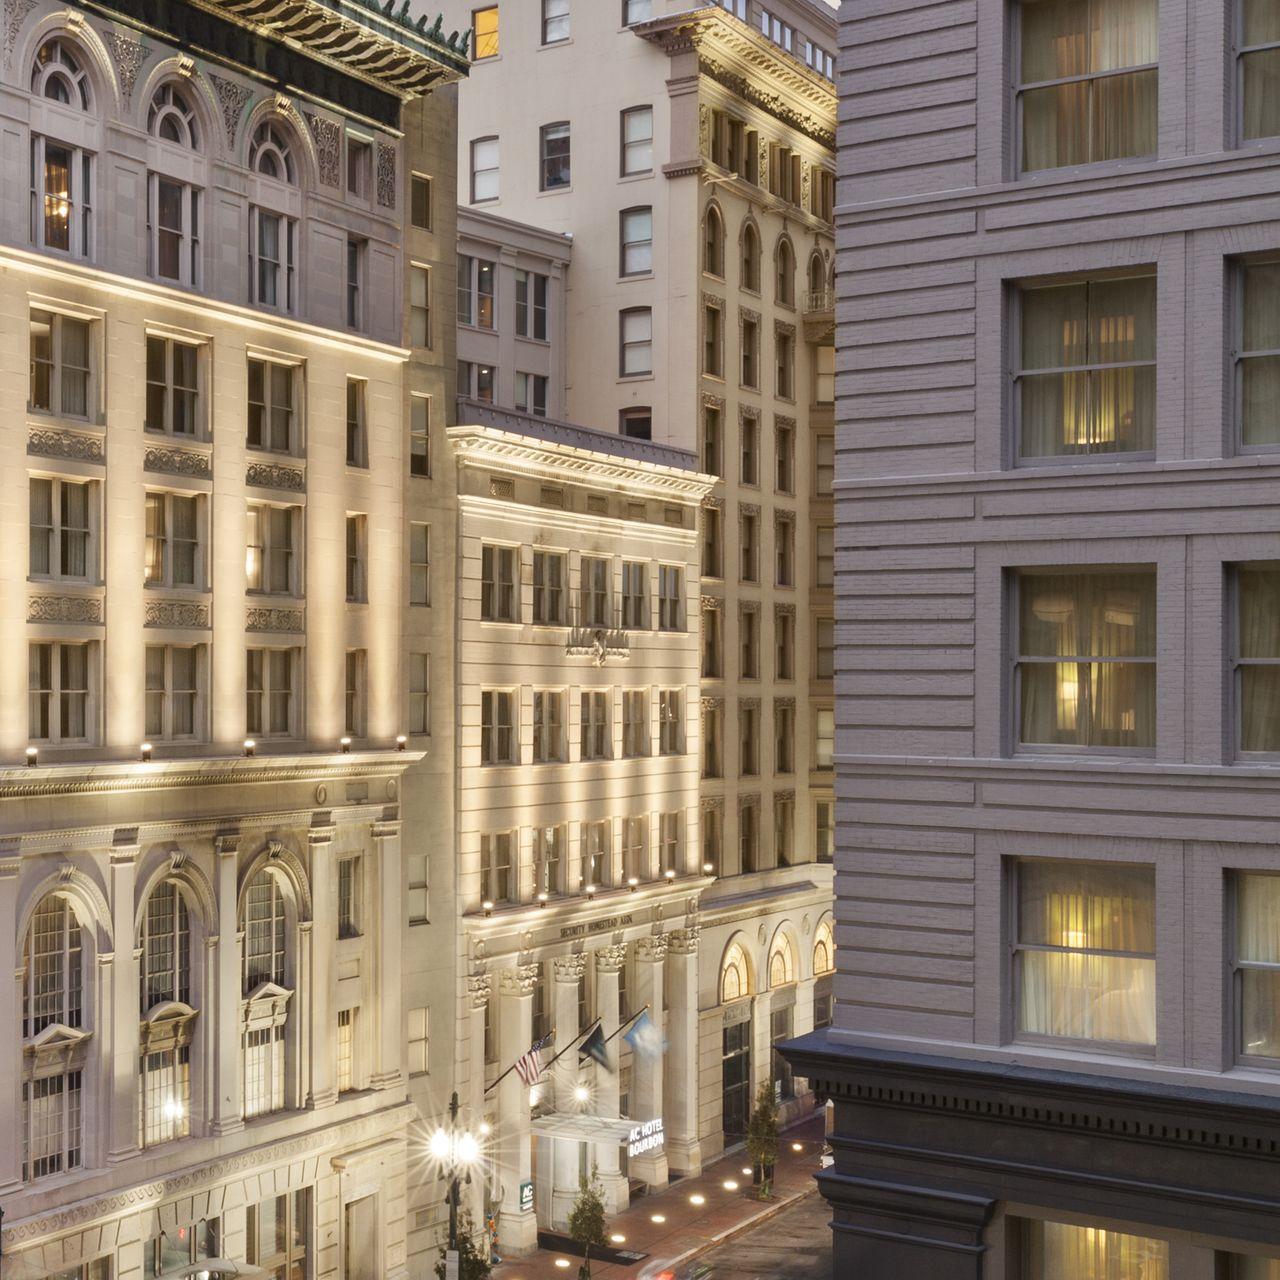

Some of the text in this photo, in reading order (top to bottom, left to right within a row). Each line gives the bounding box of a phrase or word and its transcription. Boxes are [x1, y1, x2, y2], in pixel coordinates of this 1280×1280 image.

[560, 923, 586, 939] SECURITY
[587, 917, 618, 933] HOMESTEAD
[629, 1118, 663, 1142] AC HOTEL
[629, 1131, 664, 1157] BOURBON
[522, 1184, 533, 1198] AC
